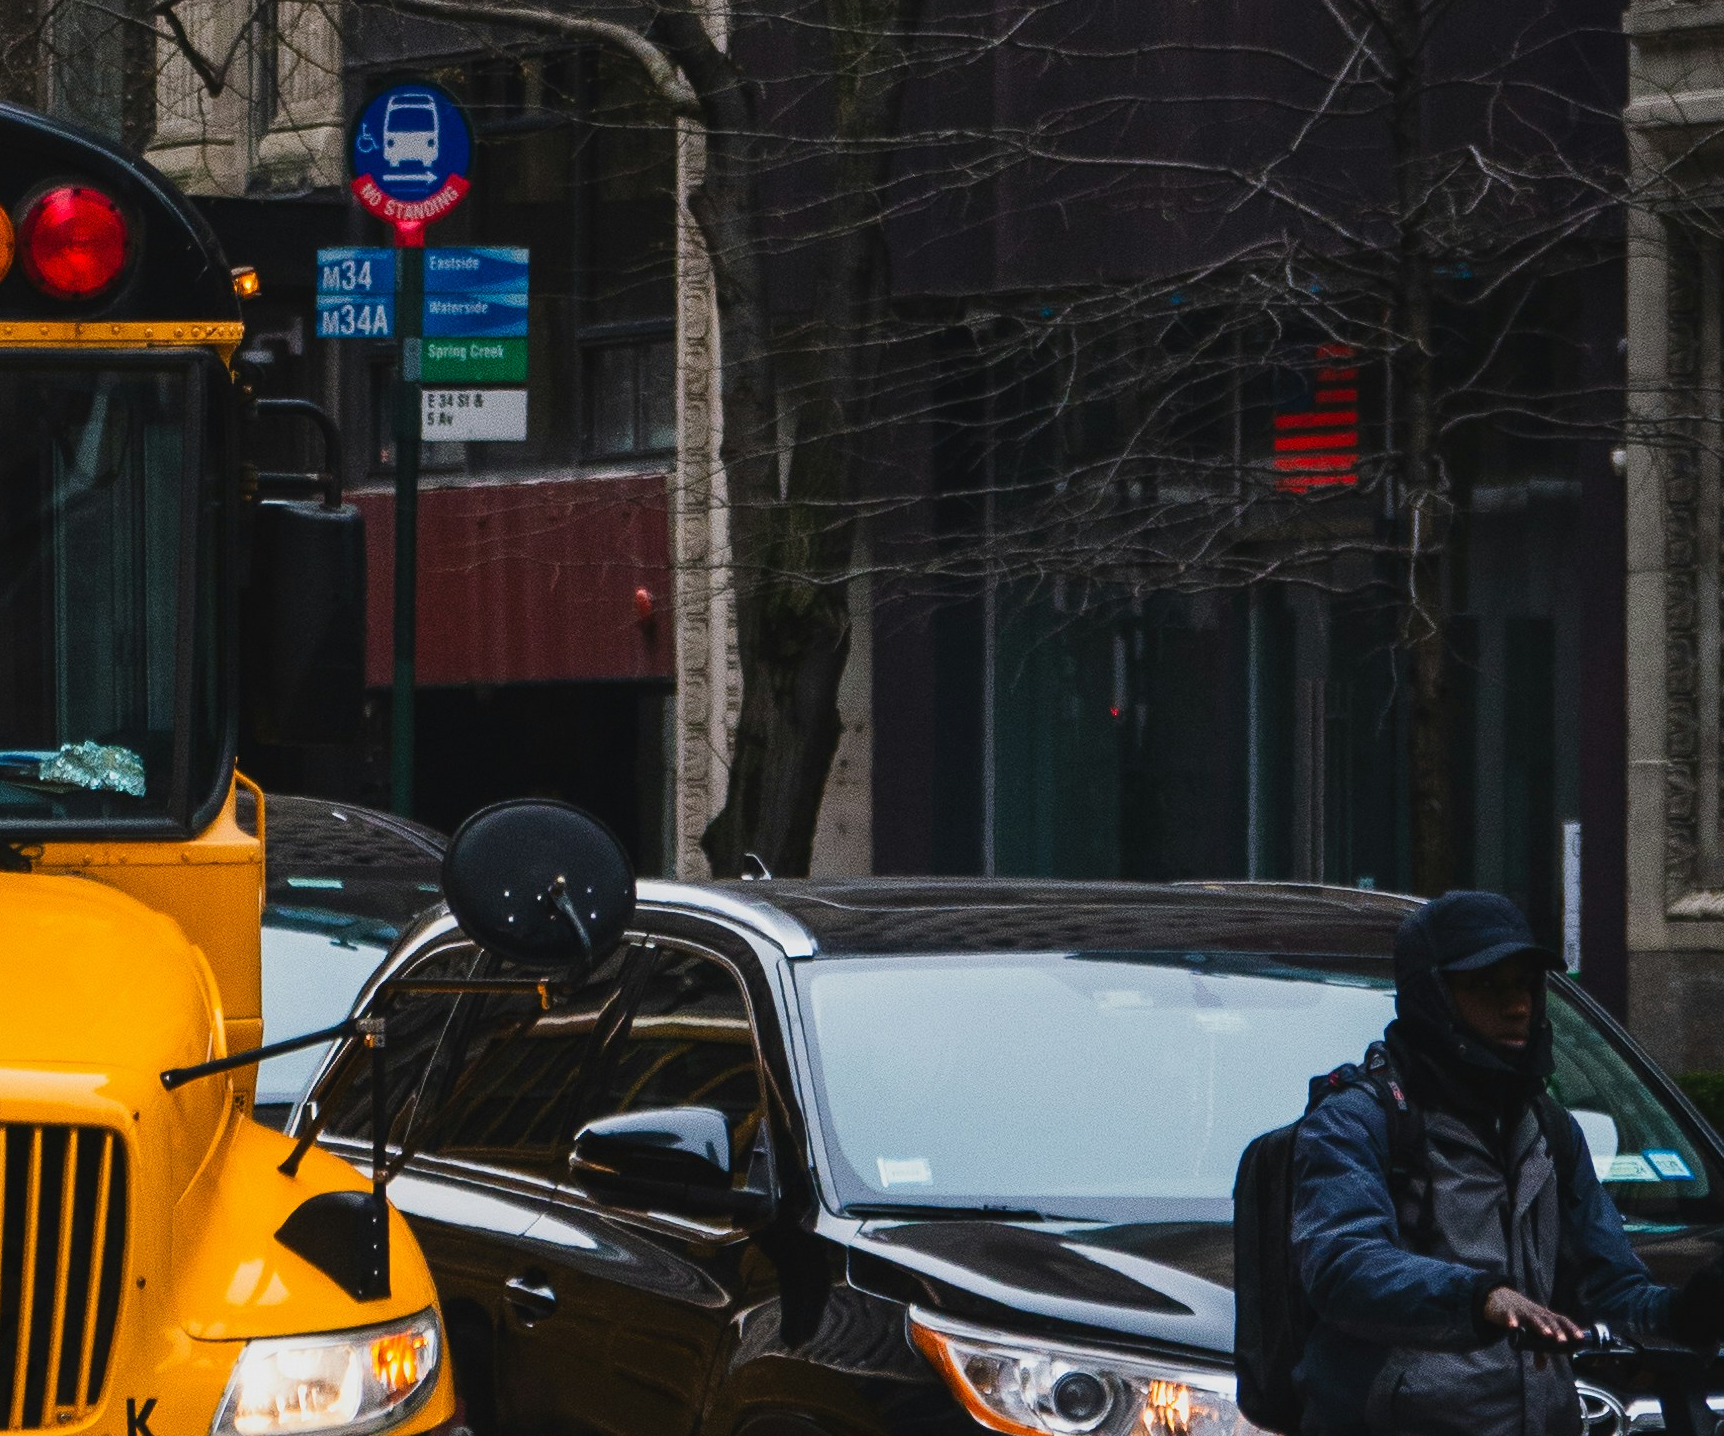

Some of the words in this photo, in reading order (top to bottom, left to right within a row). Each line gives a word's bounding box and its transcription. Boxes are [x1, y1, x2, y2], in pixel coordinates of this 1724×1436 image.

[360, 183, 382, 207] NO
[384, 185, 460, 220] STANDING
[429, 256, 480, 271] Eastside
[323, 259, 372, 290] M34
[429, 301, 489, 315] Waterside
[322, 303, 389, 335] M34A
[428, 343, 468, 362] Spring
[470, 343, 505, 359] Creek
[427, 393, 435, 408] E
[439, 393, 454, 408] 34
[457, 393, 470, 408] St
[427, 411, 435, 426] 5
[438, 411, 454, 426] Av
